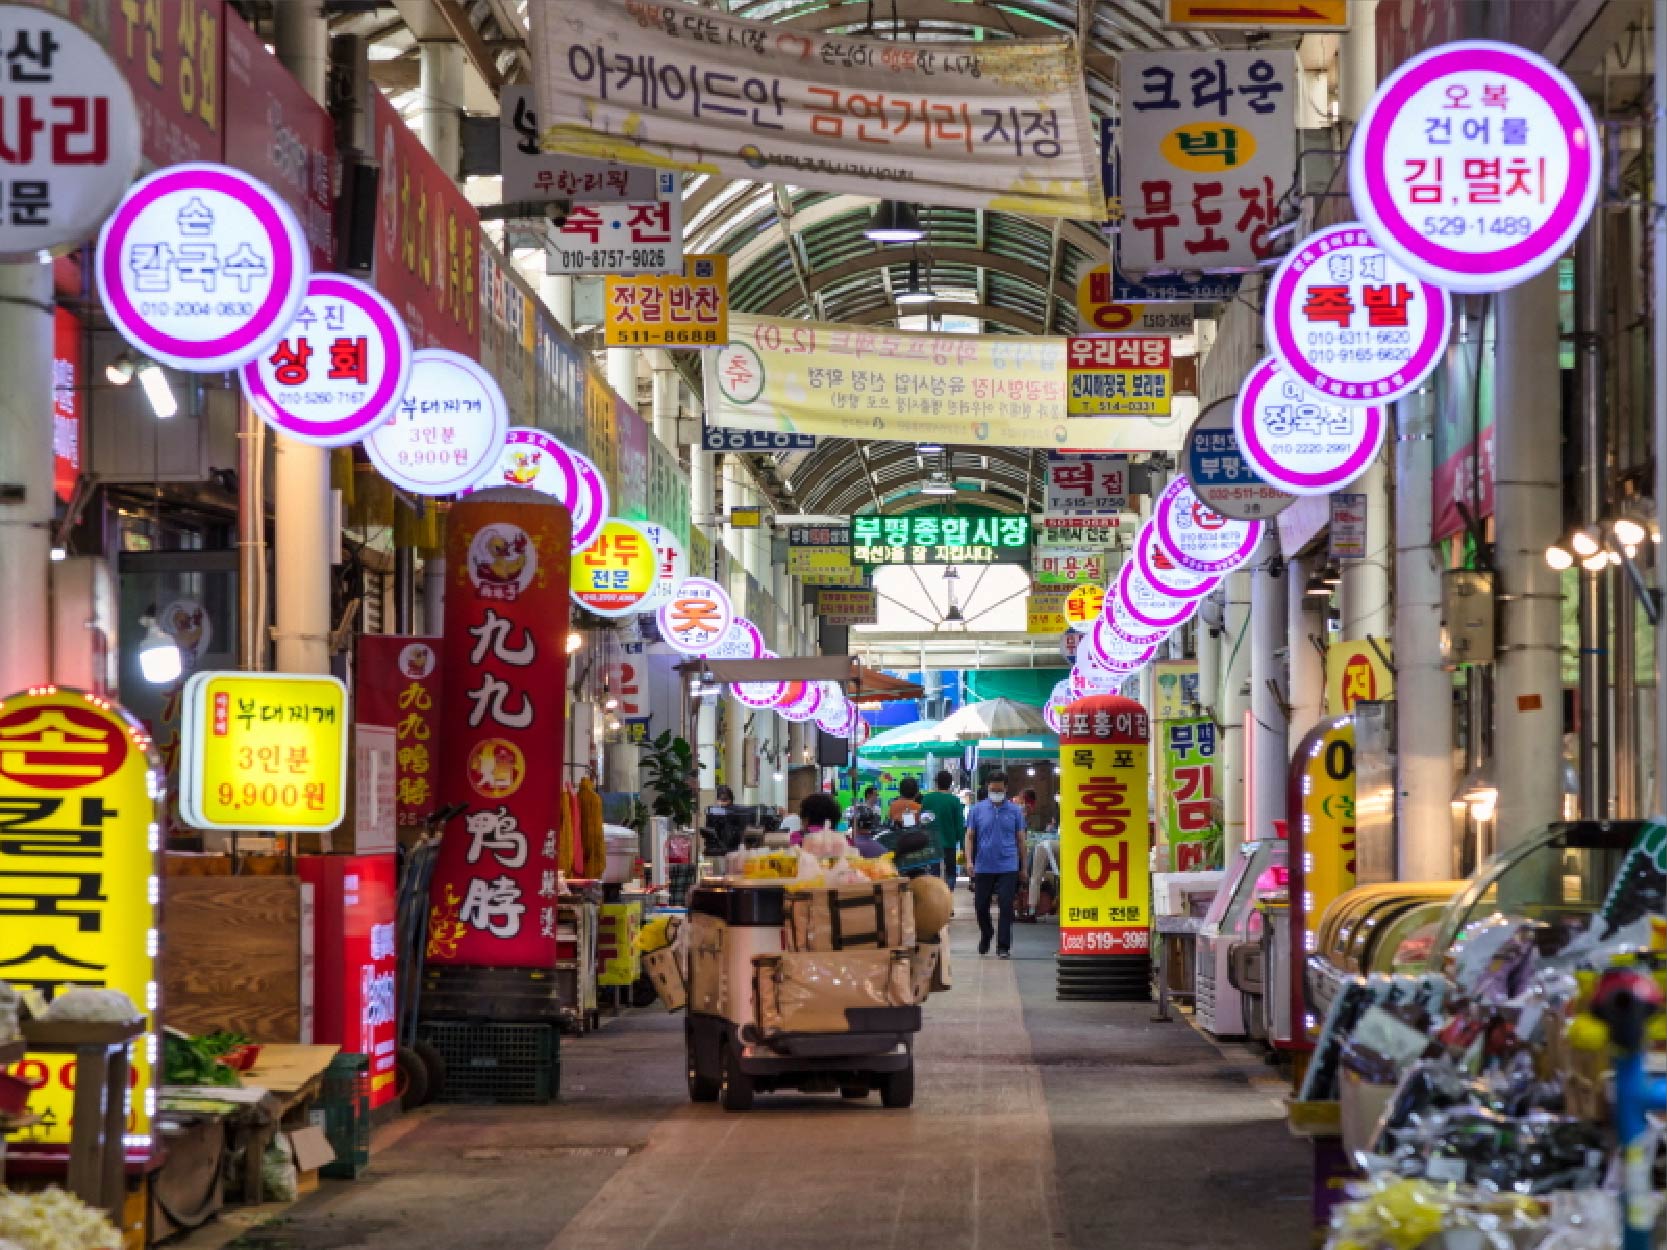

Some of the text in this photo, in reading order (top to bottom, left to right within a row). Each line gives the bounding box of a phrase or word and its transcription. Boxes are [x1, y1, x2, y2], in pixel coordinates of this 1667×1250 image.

[0, 30, 59, 83] 산
[1132, 59, 1284, 117] 크라운
[1442, 84, 1509, 111] 오복
[804, 85, 973, 152] 금연거리
[981, 107, 1062, 158] 지정
[1424, 117, 1529, 145] 건어물
[1176, 128, 1238, 165] 빅
[533, 169, 628, 196] 무한리필
[1404, 156, 1546, 205] 김,멸치
[0, 181, 50, 226] 문
[177, 197, 214, 235] 손
[1132, 175, 1279, 262] 무도장
[130, 243, 269, 292] 칼국수
[295, 304, 345, 331] 수진
[614, 284, 720, 322] 젓갈반찬
[1302, 283, 1414, 327] 족발
[269, 337, 369, 386] 상회
[1072, 339, 1165, 366] 우리식당
[401, 395, 482, 421] 부대찌개
[408, 426, 456, 444] 3인분
[1053, 462, 1122, 497] 떡 집
[583, 534, 639, 565] 만두
[854, 516, 1028, 547] 부평종합시장
[592, 569, 630, 589] 전문
[1043, 557, 1101, 580] 미용실
[671, 598, 721, 632] 옷
[469, 609, 535, 729] 九九
[235, 697, 336, 731] 부대찌개
[0, 709, 105, 776] 손
[1171, 722, 1216, 759] 부평
[239, 745, 311, 774] 3인분
[1072, 749, 1136, 770] 목포
[1173, 765, 1214, 831] 김
[1075, 776, 1132, 899] 홍어
[1108, 906, 1141, 923] 전문
